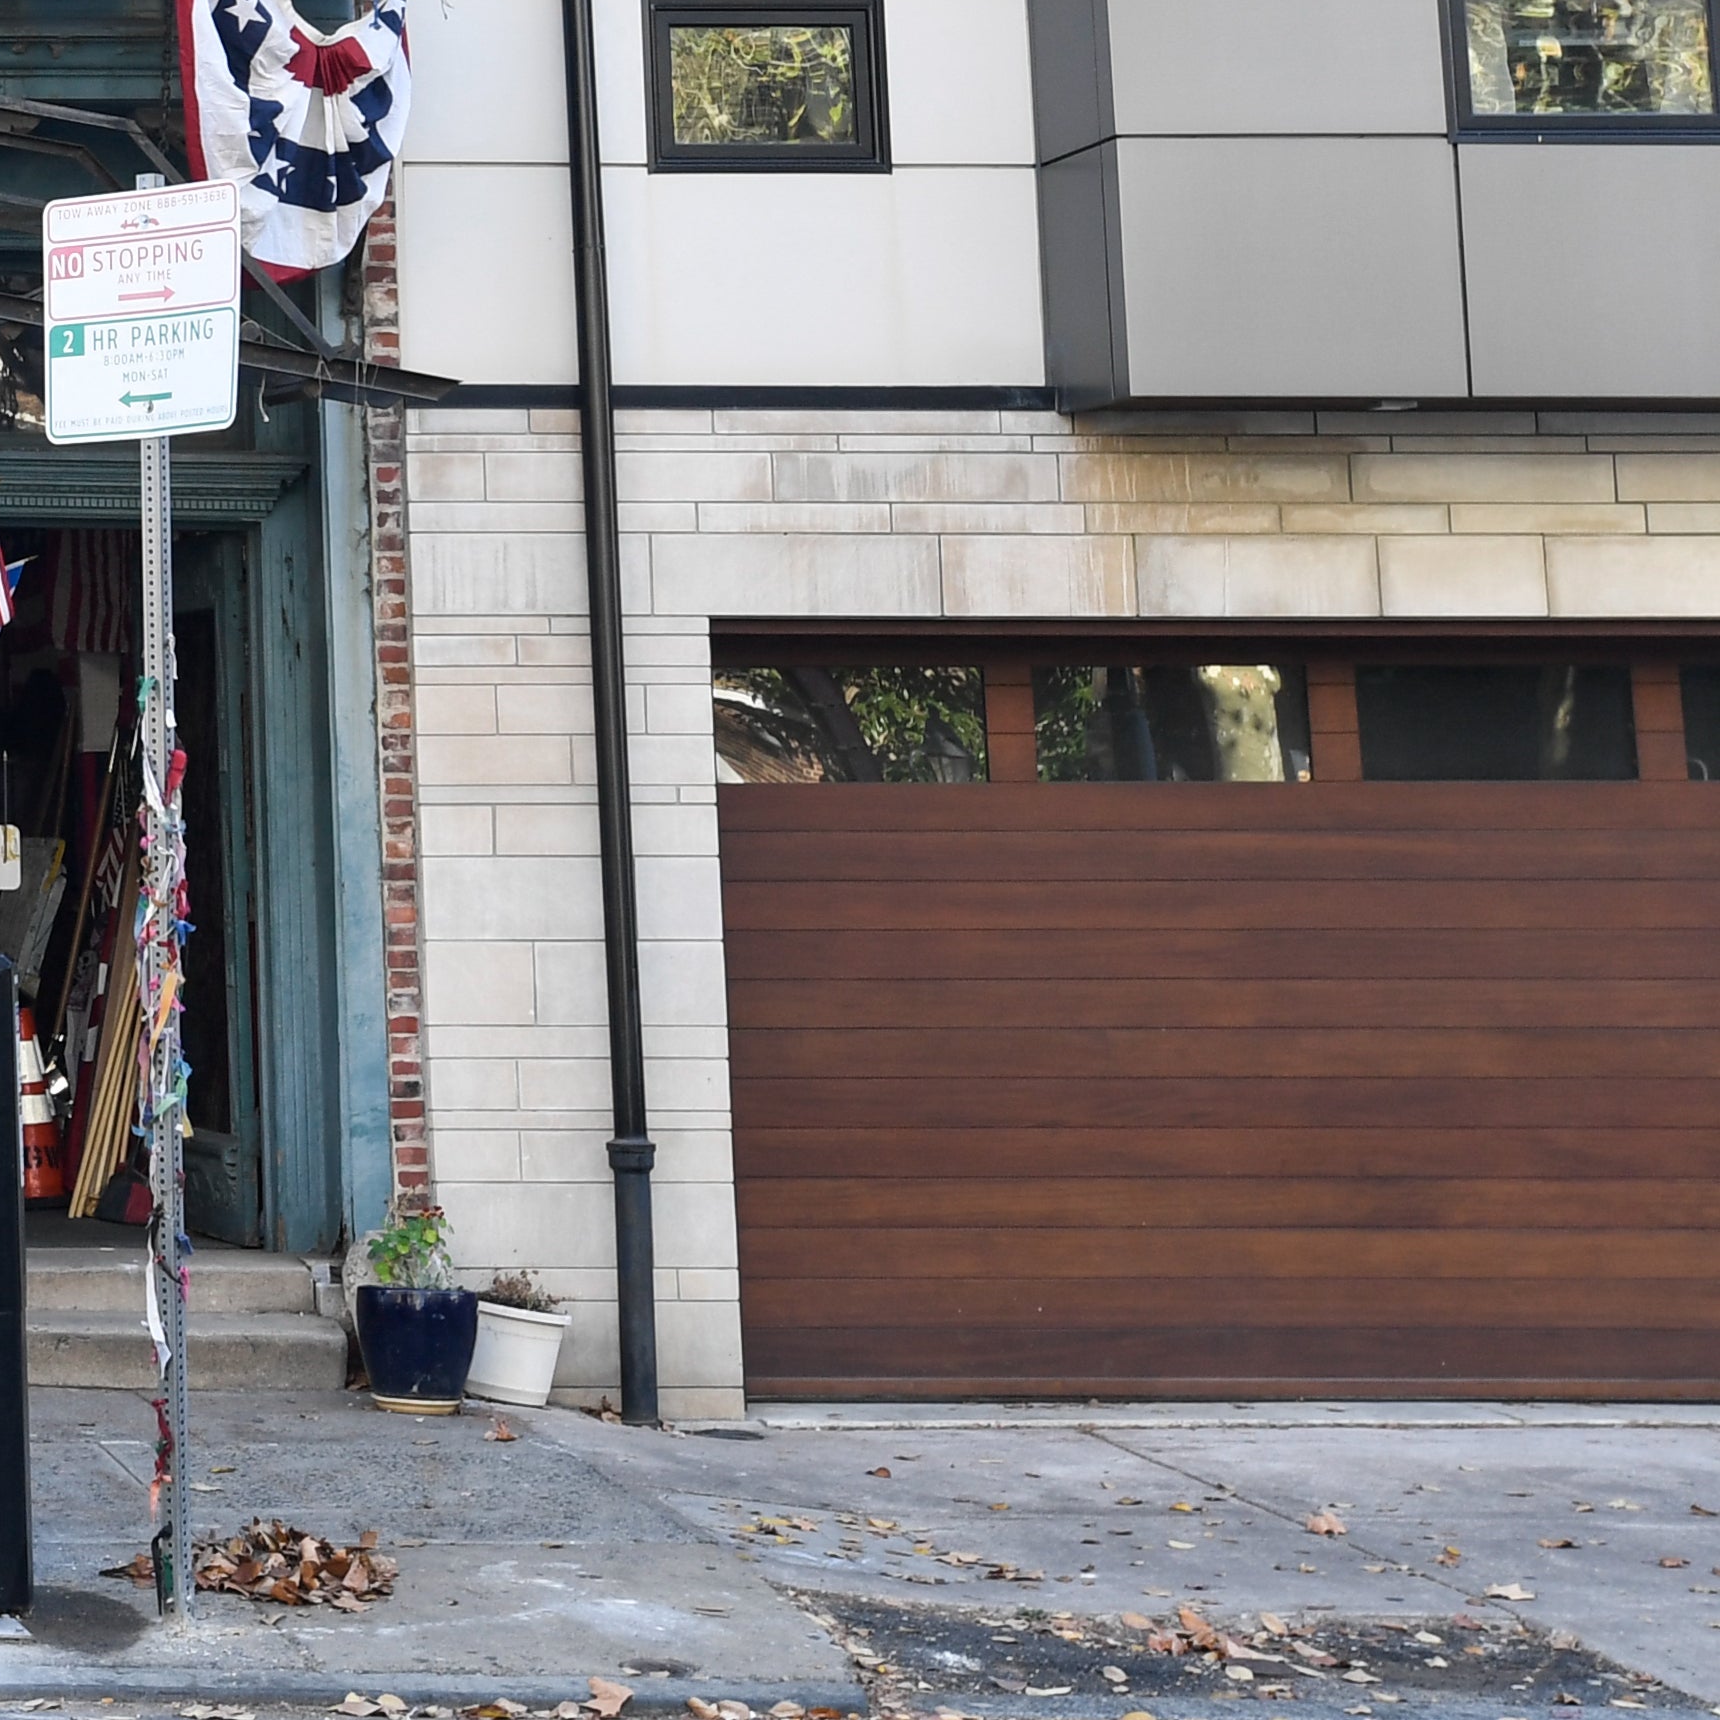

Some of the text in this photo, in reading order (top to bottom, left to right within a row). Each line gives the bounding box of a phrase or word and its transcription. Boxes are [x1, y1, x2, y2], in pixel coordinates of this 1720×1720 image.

[58, 207, 81, 220] TOW
[86, 203, 117, 217] AWAY
[123, 199, 152, 213] ZONE
[51, 239, 204, 279] NO STOPPING
[118, 269, 173, 284] ANY TIME
[62, 318, 214, 355] 2 HR PARKING
